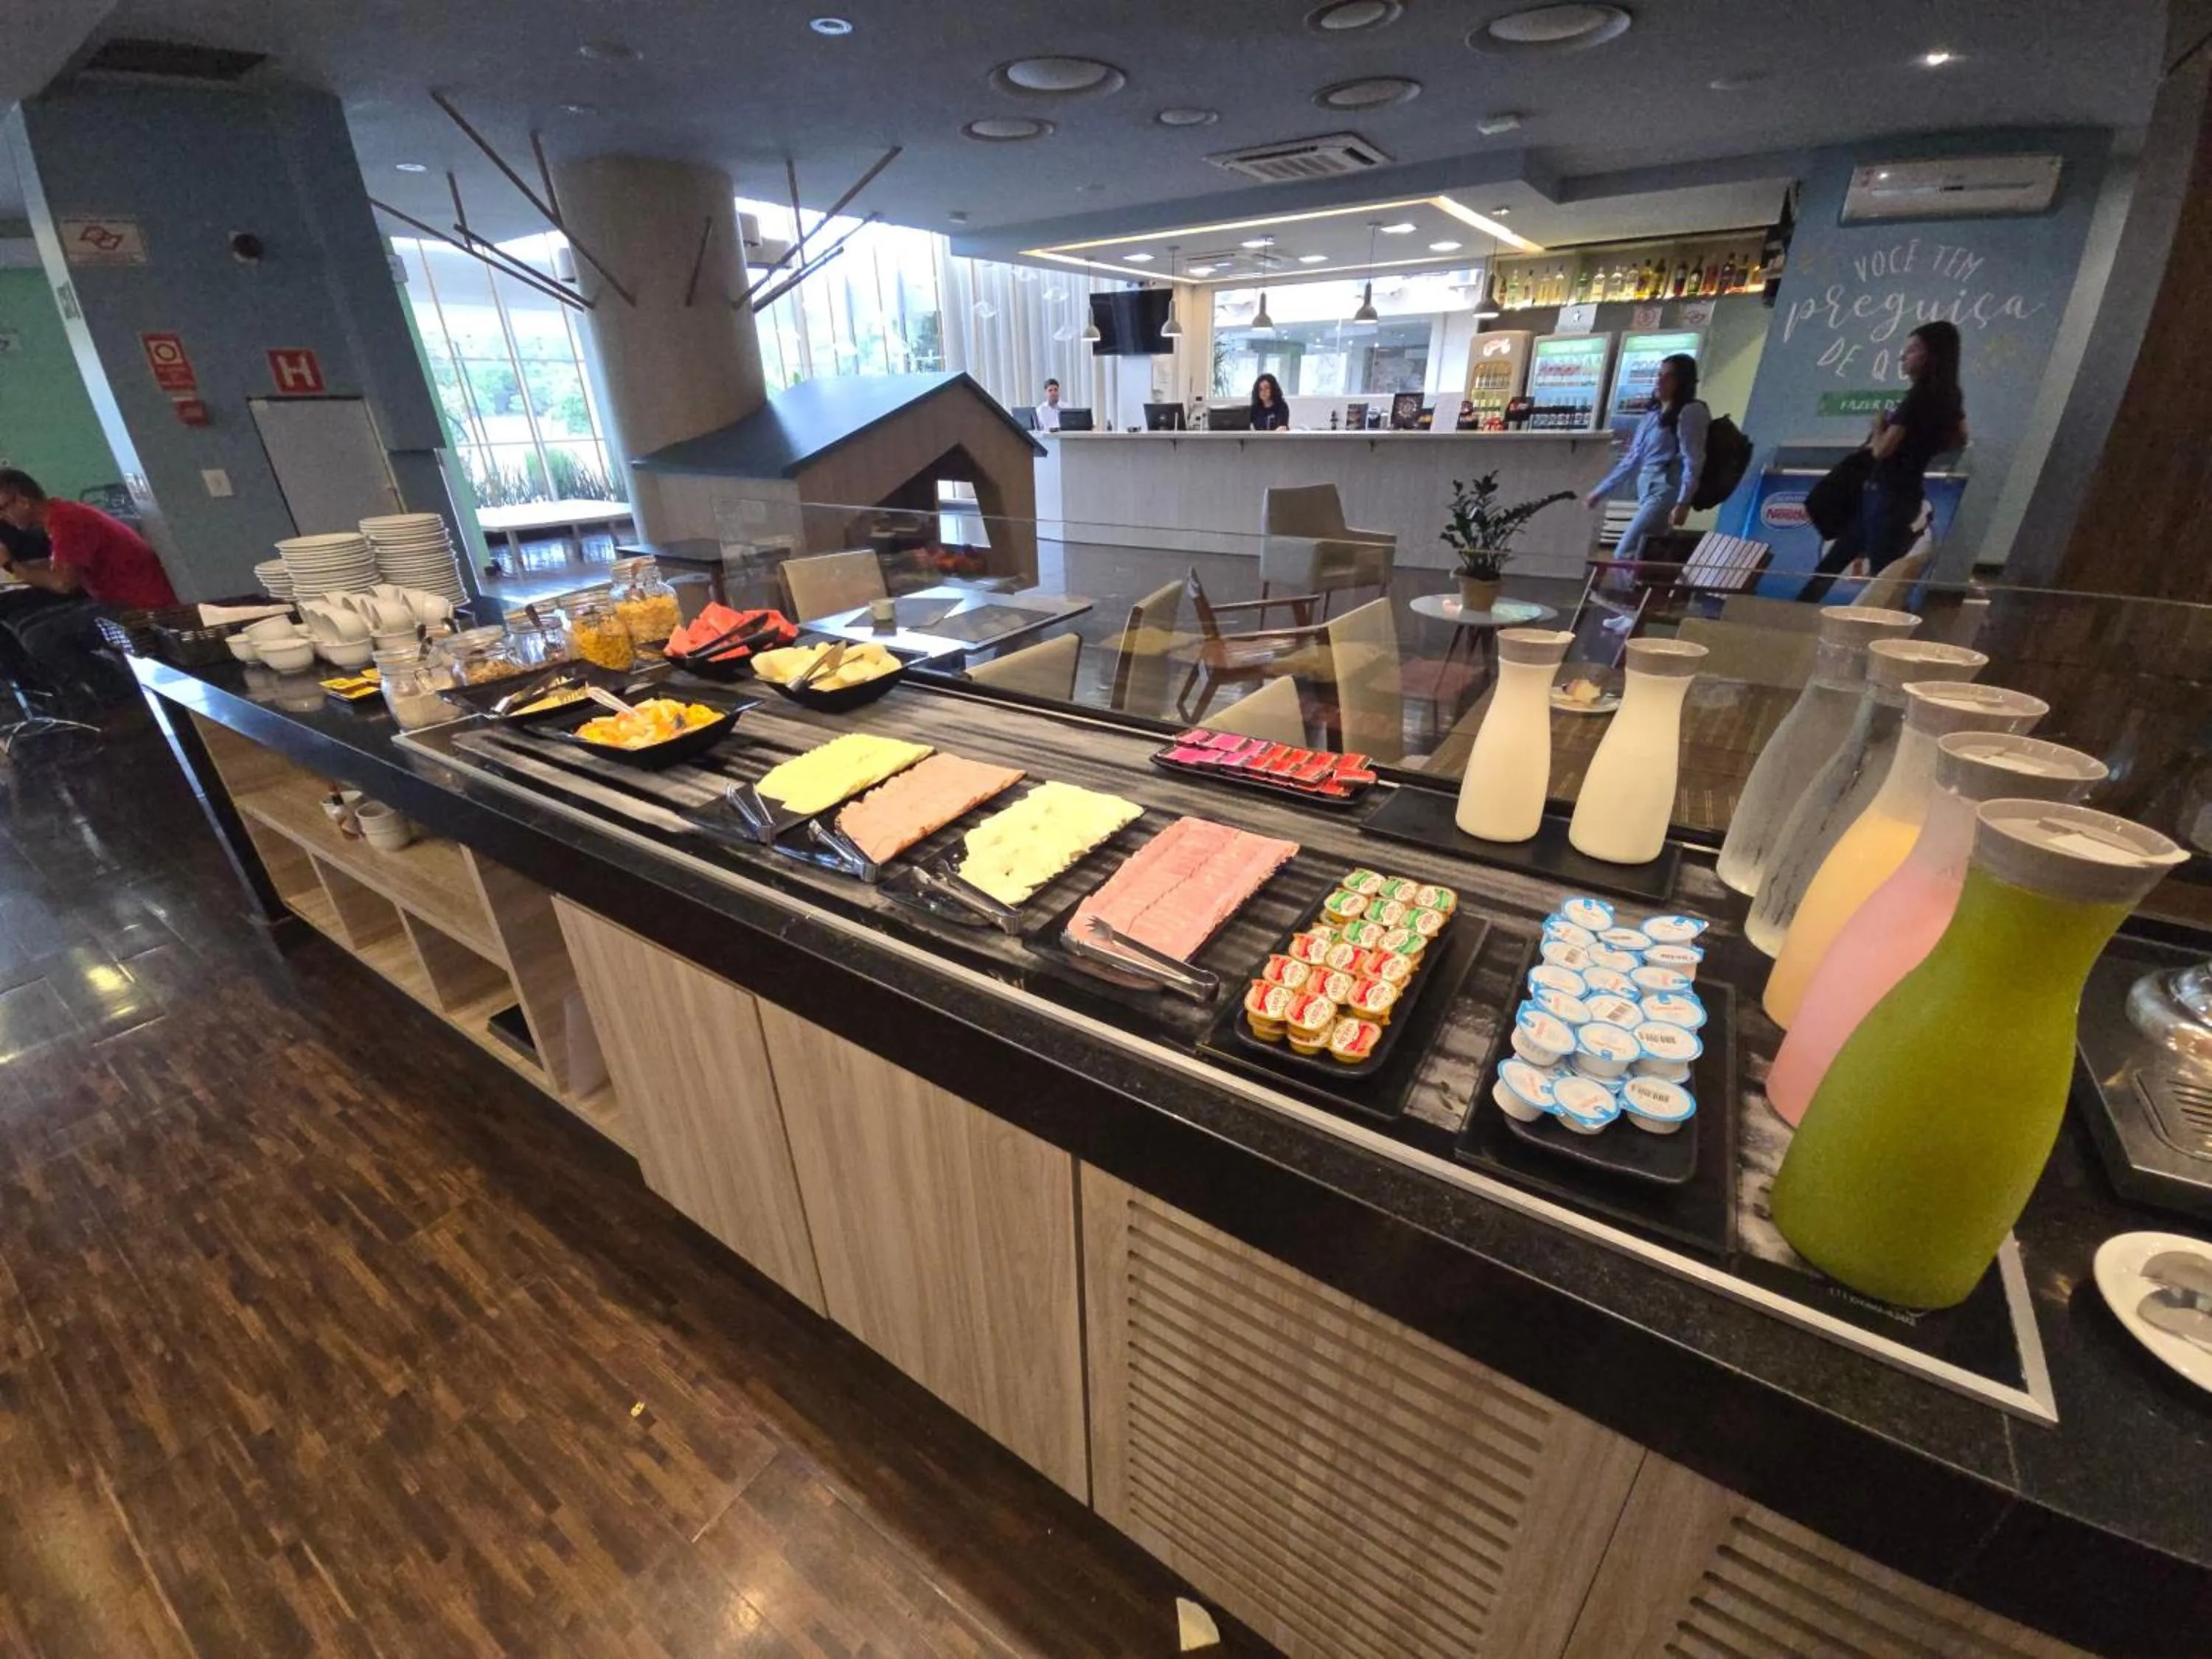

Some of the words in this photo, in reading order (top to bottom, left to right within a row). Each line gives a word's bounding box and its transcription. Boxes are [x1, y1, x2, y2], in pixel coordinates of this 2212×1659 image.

[1854, 238, 1920, 283] VOCÊ
[1932, 244, 1985, 283] TEM
[1783, 283, 2045, 343] preguiça
[276, 354, 317, 389] H
[1816, 337, 1864, 378] DE
